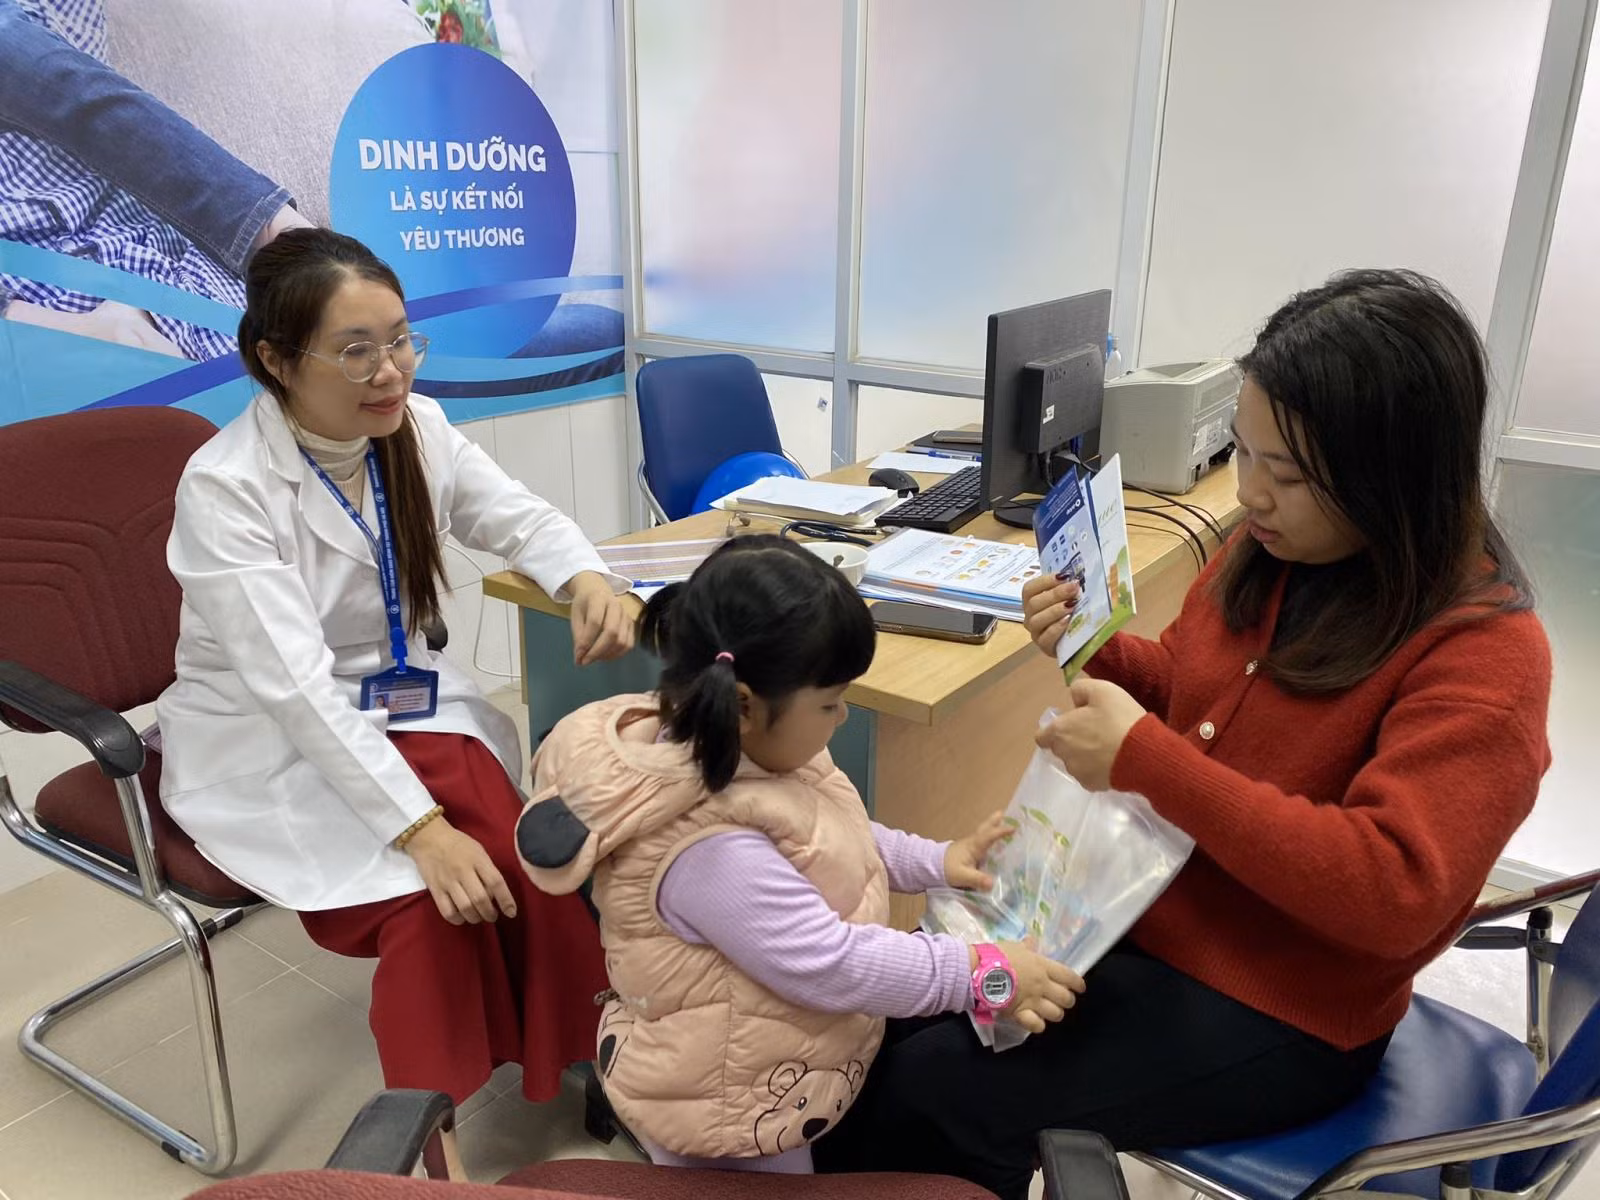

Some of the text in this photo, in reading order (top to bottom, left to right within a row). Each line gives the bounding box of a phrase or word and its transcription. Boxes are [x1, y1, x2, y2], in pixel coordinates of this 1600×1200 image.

[359, 136, 547, 172] DINH DƯỠNG
[390, 182, 524, 215] LÀ SỰ KẾT NỐI
[400, 226, 525, 251] YÊU THƯƠNG
